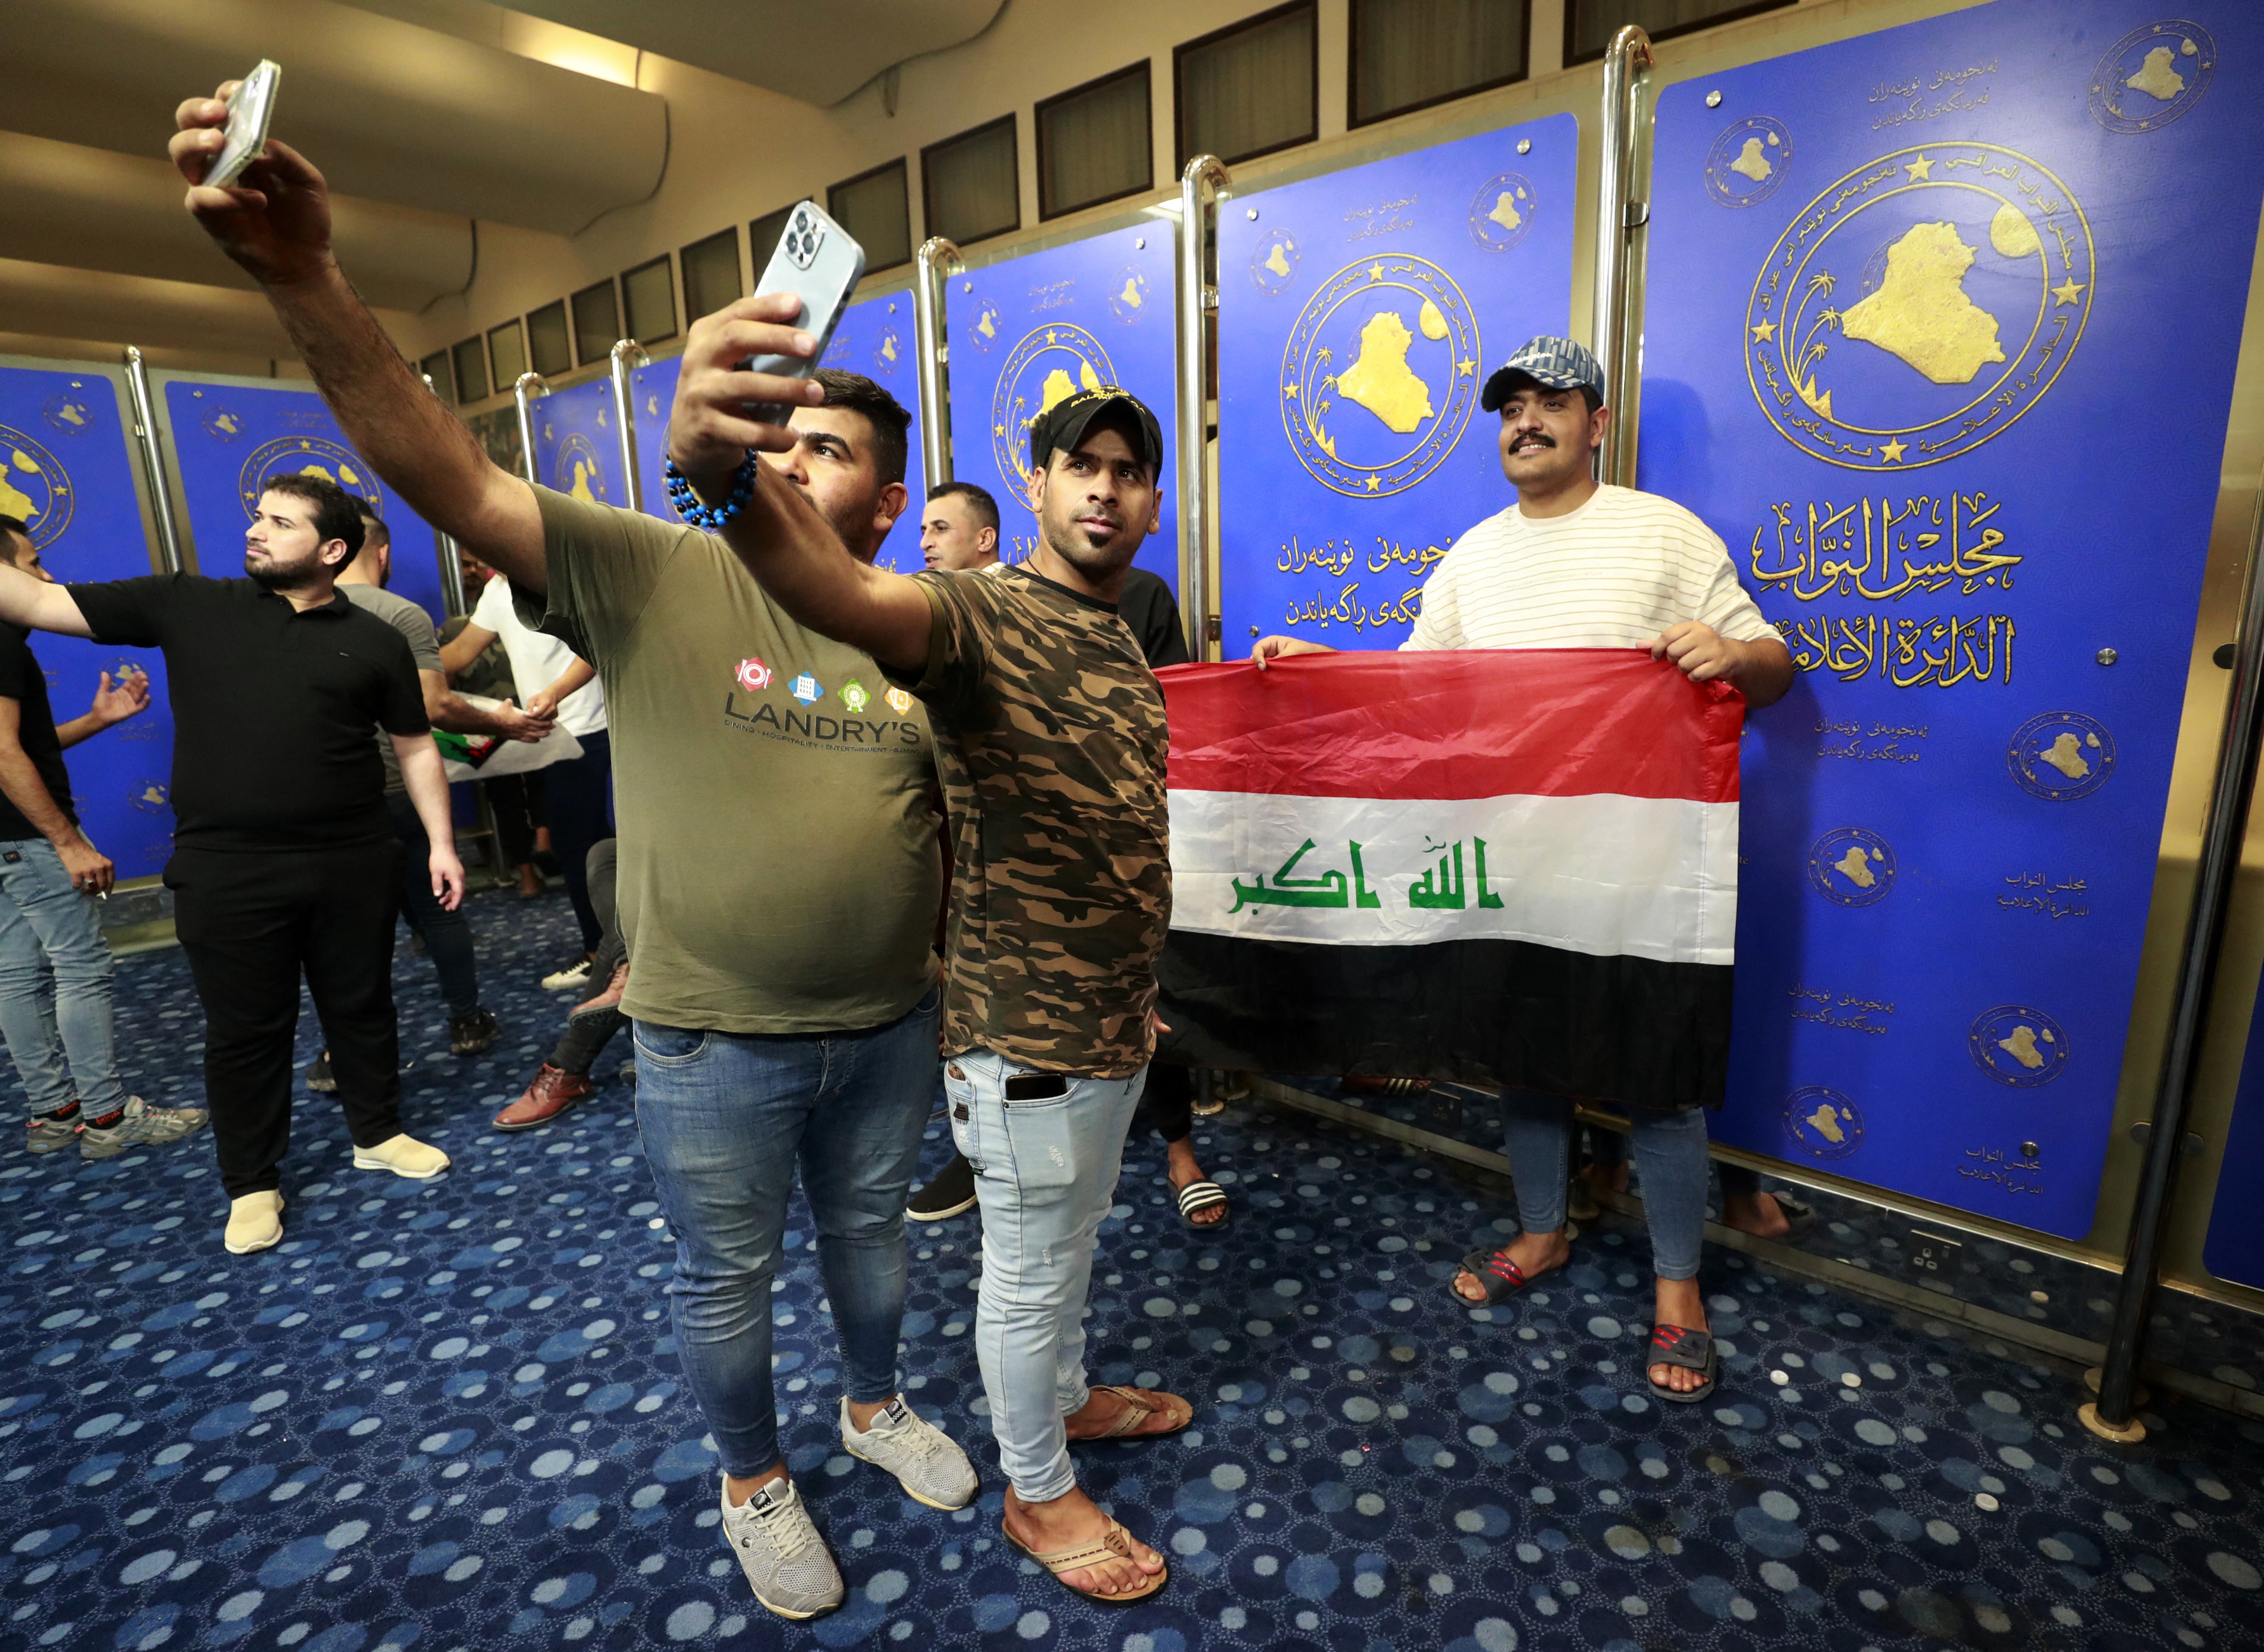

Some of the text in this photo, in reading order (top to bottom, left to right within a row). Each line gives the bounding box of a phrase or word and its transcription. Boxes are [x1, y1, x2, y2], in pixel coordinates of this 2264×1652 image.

[724, 691, 921, 745] LANDRY'S
[725, 719, 755, 733] DINING
[762, 731, 819, 748] HOSPITALITY
[825, 743, 888, 753] ENTERTAINMENT
